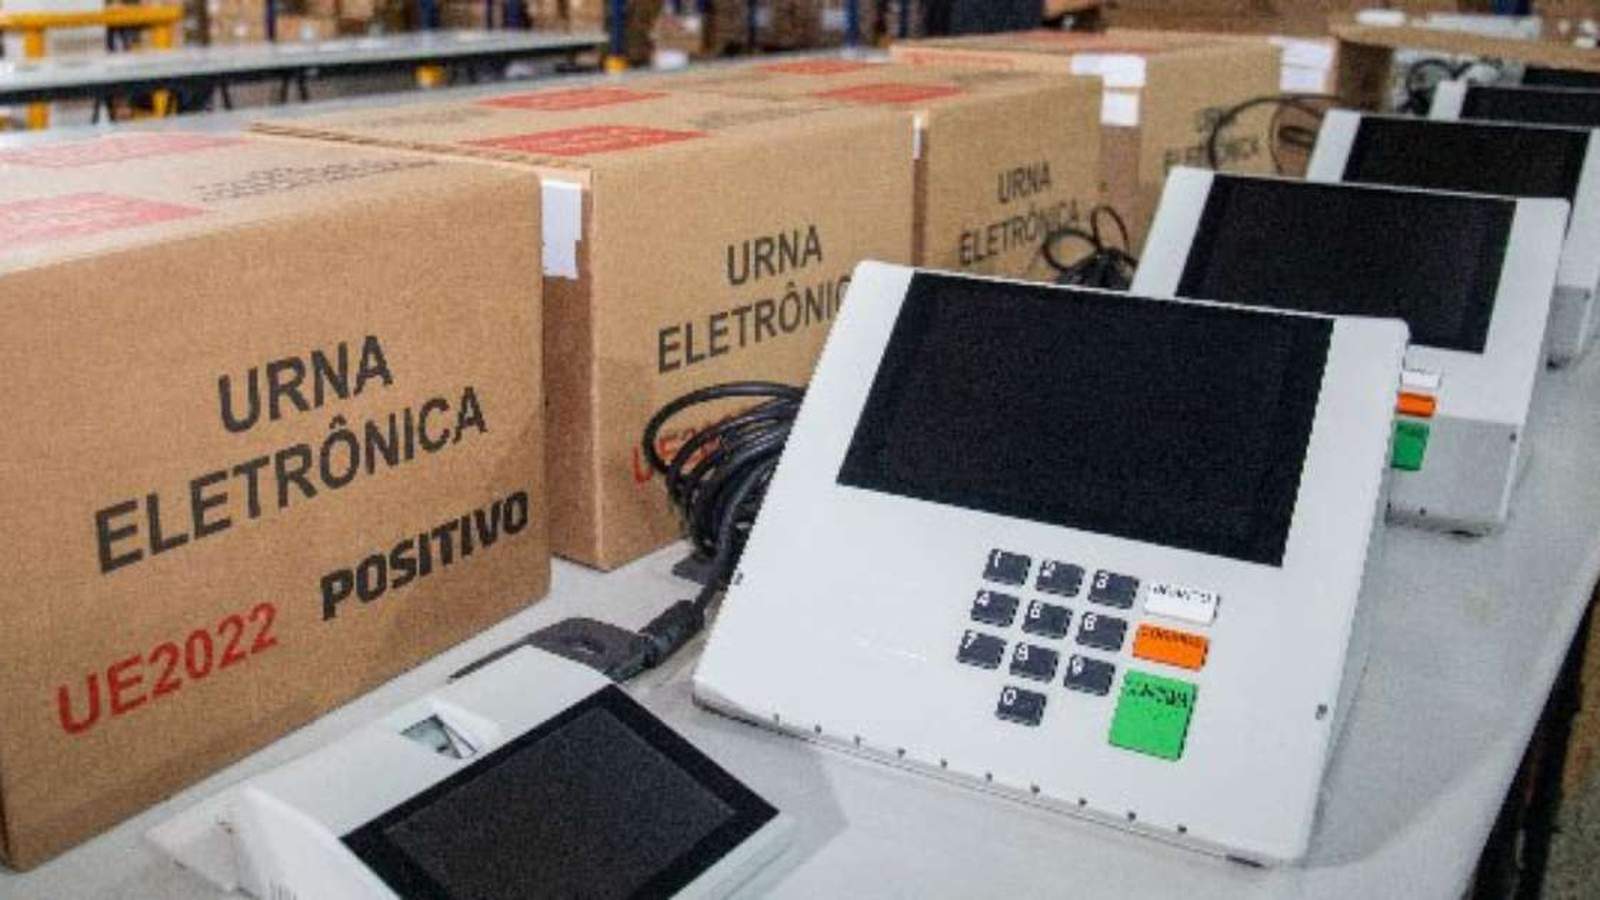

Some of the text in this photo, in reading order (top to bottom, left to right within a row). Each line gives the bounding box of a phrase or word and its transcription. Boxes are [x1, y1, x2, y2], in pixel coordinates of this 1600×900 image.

[997, 161, 1051, 204] URNA
[726, 224, 823, 286] URNA
[657, 275, 852, 375] ELETRÔNIC
[217, 335, 394, 434] URNA
[94, 386, 488, 575] ELETRÔNICA
[320, 490, 530, 622] POSITIVO
[57, 601, 280, 736] UE2022
[963, 631, 978, 649] 7
[1003, 689, 1016, 706] 0
